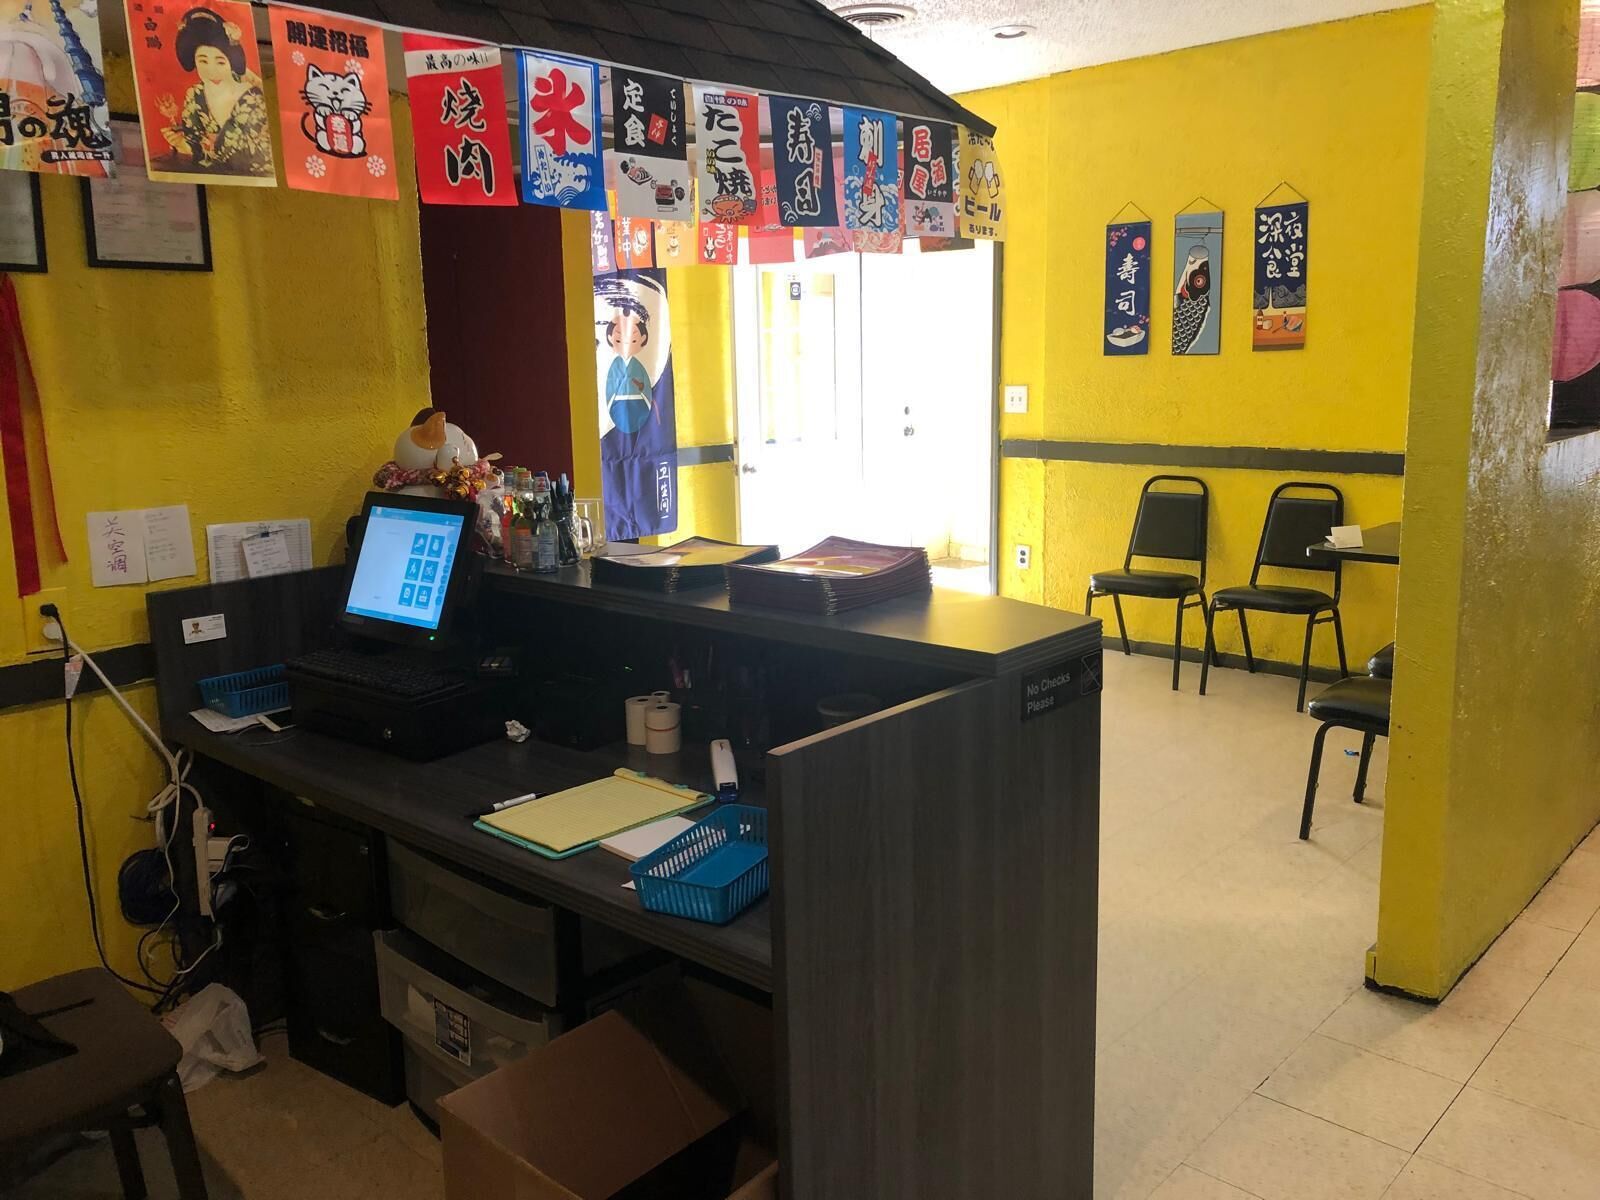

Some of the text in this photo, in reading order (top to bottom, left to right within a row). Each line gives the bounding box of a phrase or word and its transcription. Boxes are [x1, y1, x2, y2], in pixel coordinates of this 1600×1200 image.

[286, 20, 369, 58] 開運招福
[623, 78, 645, 147] 定食
[859, 115, 886, 228] 刺身
[965, 195, 1002, 221] ビール
[1115, 252, 1141, 316] 寿司
[102, 516, 127, 573] 关空调
[1027, 672, 1071, 697] No Checks
[1027, 696, 1054, 713] Please
